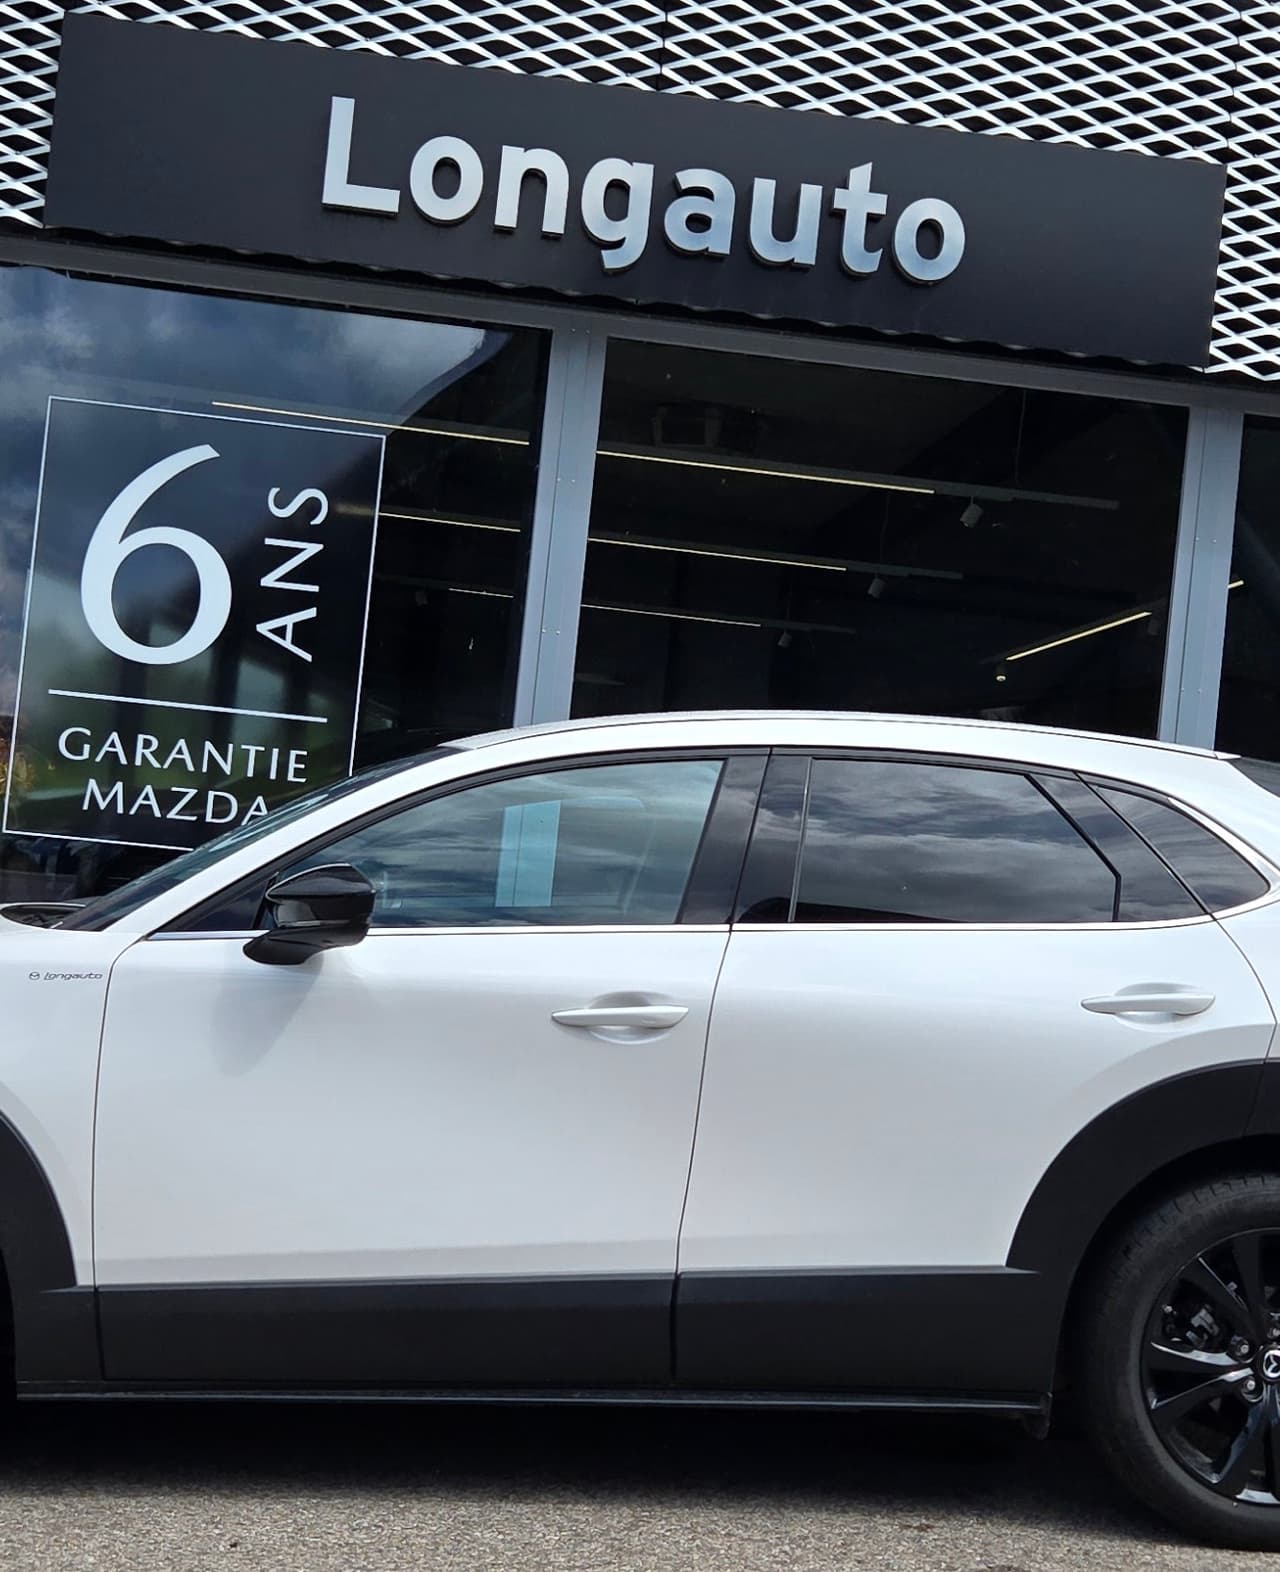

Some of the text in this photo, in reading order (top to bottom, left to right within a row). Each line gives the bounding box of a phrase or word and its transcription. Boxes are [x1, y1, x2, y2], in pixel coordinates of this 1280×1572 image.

[321, 96, 966, 284] Longauto
[81, 444, 232, 665] 6
[256, 486, 329, 662] ANS
[58, 726, 310, 783] GARANTIE
[82, 778, 270, 826] MAZDA
[43, 971, 103, 981] Longauto
